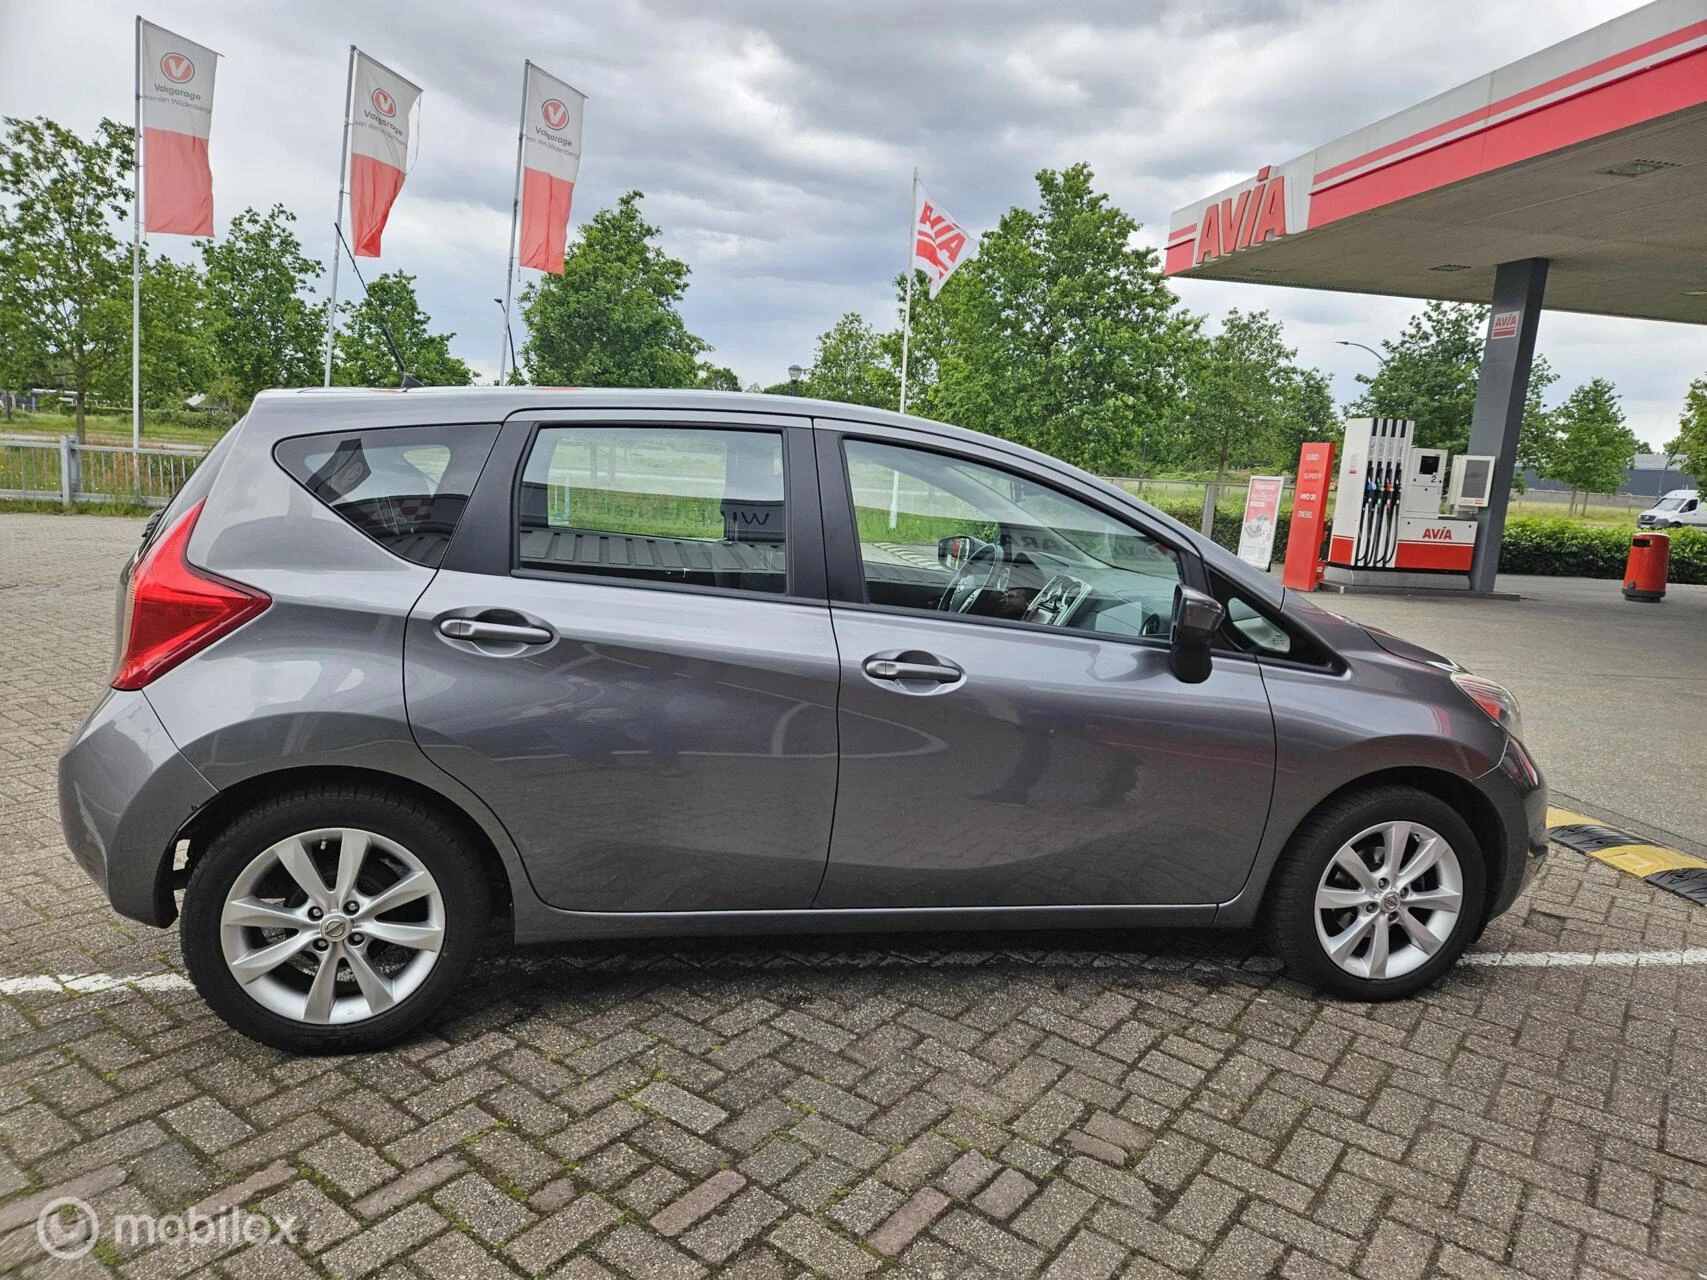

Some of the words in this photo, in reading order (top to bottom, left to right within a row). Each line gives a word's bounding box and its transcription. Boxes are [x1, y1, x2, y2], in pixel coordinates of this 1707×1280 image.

[154, 83, 201, 101] Vakgarage
[1430, 475, 1437, 484] 2
[1422, 526, 1453, 541] AVIA
